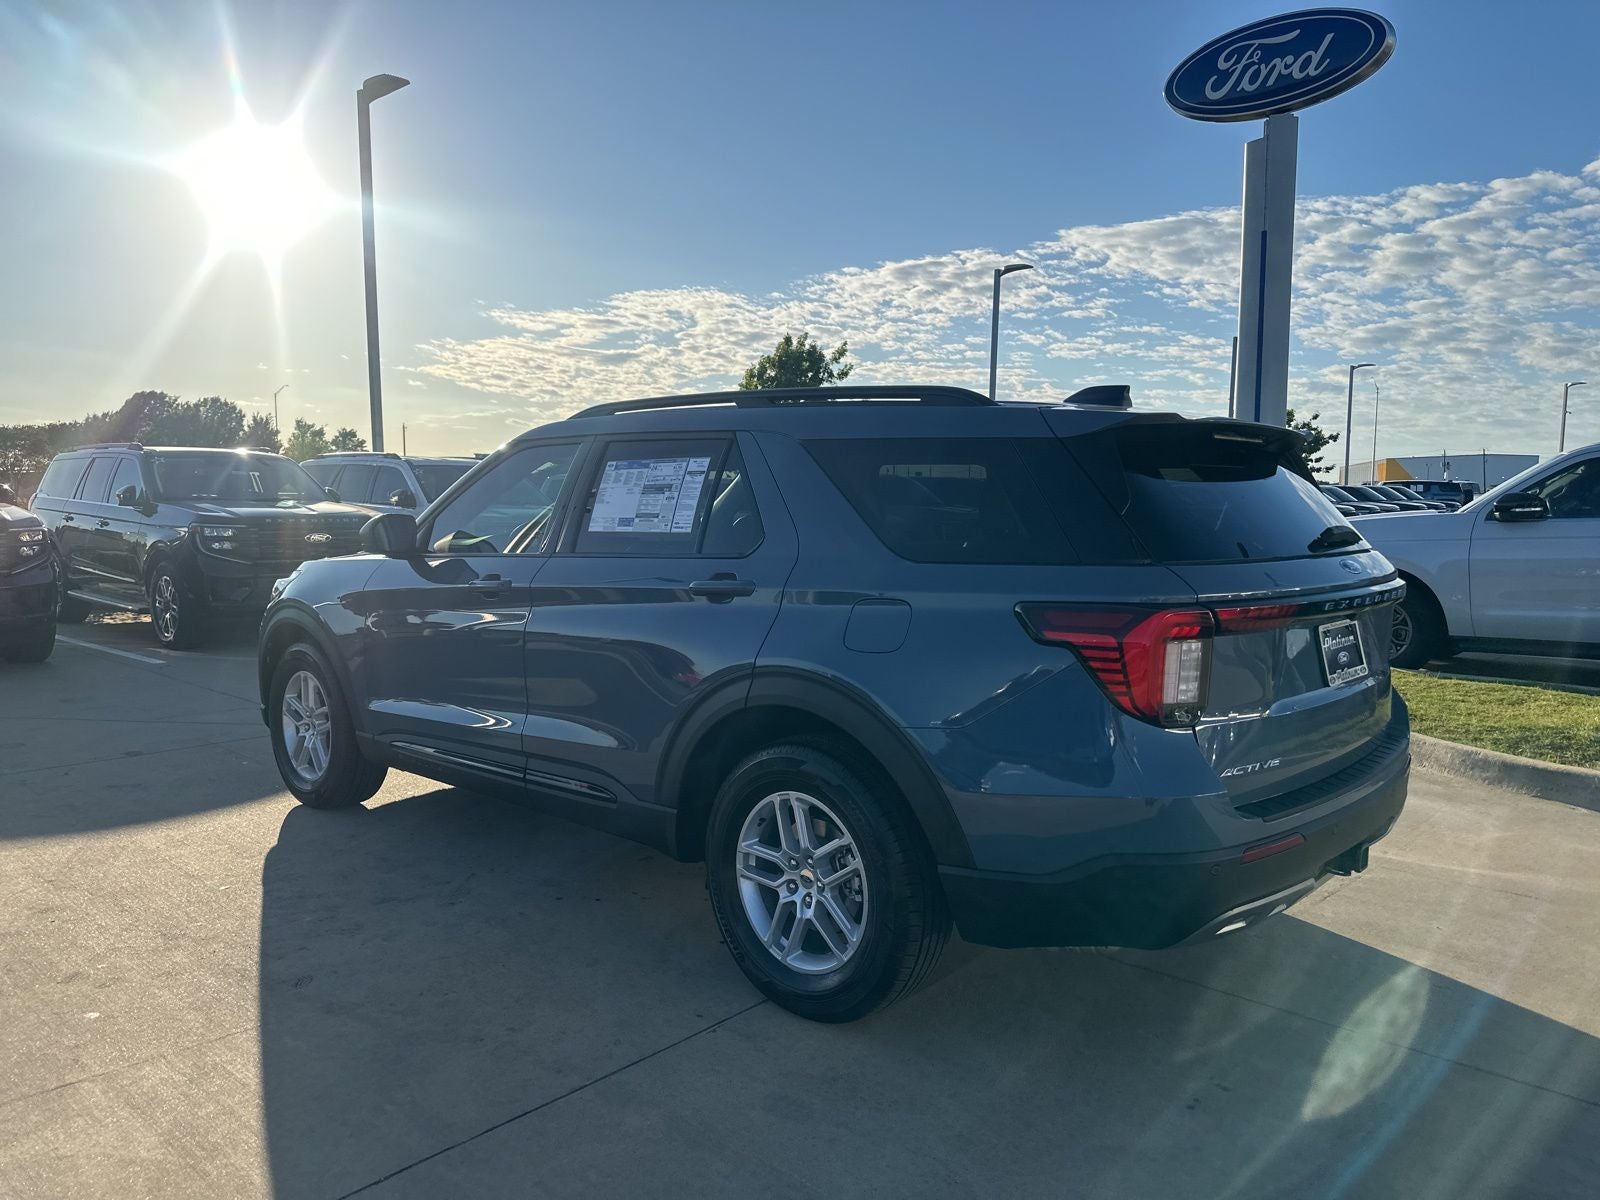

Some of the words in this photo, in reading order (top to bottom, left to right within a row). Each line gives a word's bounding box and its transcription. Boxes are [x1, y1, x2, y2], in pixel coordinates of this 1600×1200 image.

[1205, 29, 1335, 100] Ford
[1325, 589, 1406, 610] EXPLORER
[1322, 634, 1357, 651] Platinum
[1220, 758, 1281, 777] ACTIVE
